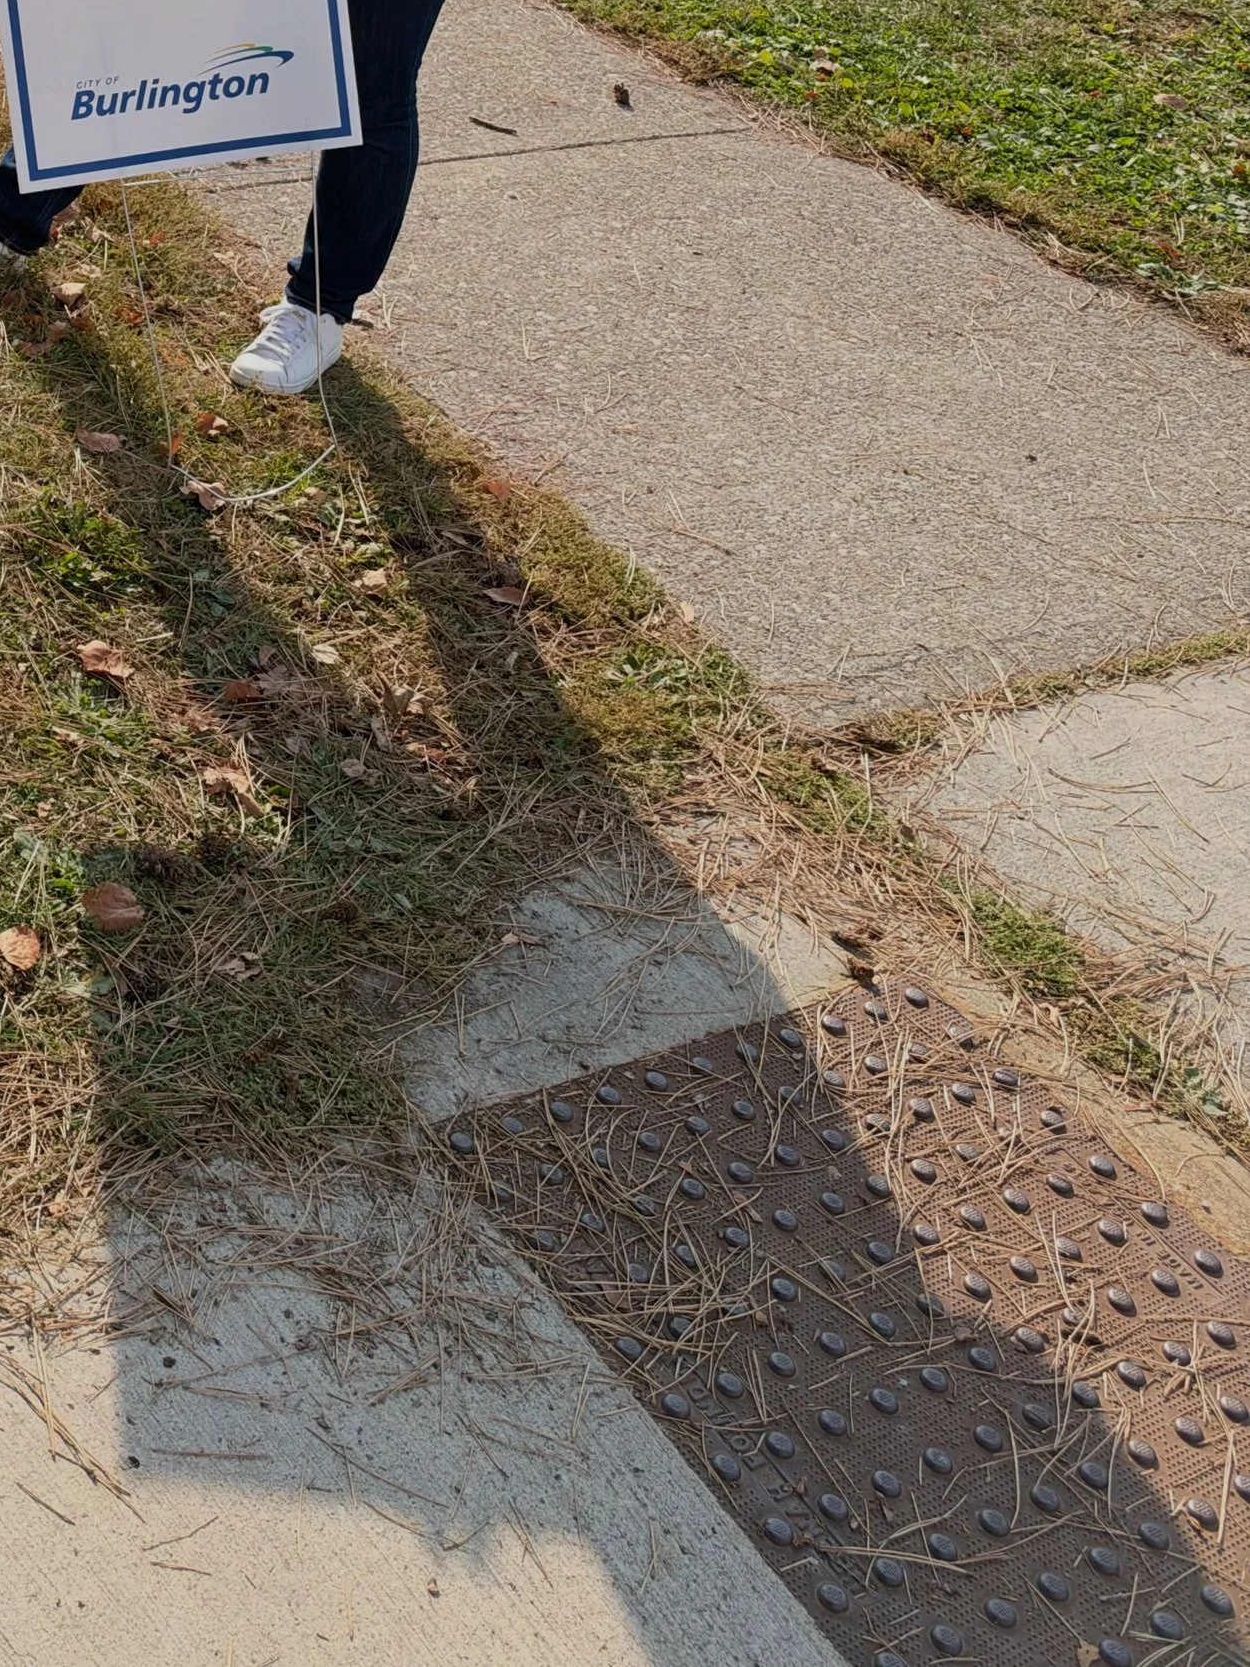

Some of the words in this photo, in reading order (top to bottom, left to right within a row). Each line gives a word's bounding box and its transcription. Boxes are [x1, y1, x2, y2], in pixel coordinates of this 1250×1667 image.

[70, 72, 270, 121] Burlington
[76, 78, 102, 90] CITY
[105, 75, 120, 86] OF
[1136, 1230, 1157, 1247] IN
[1156, 1248, 1205, 1291] MADE
